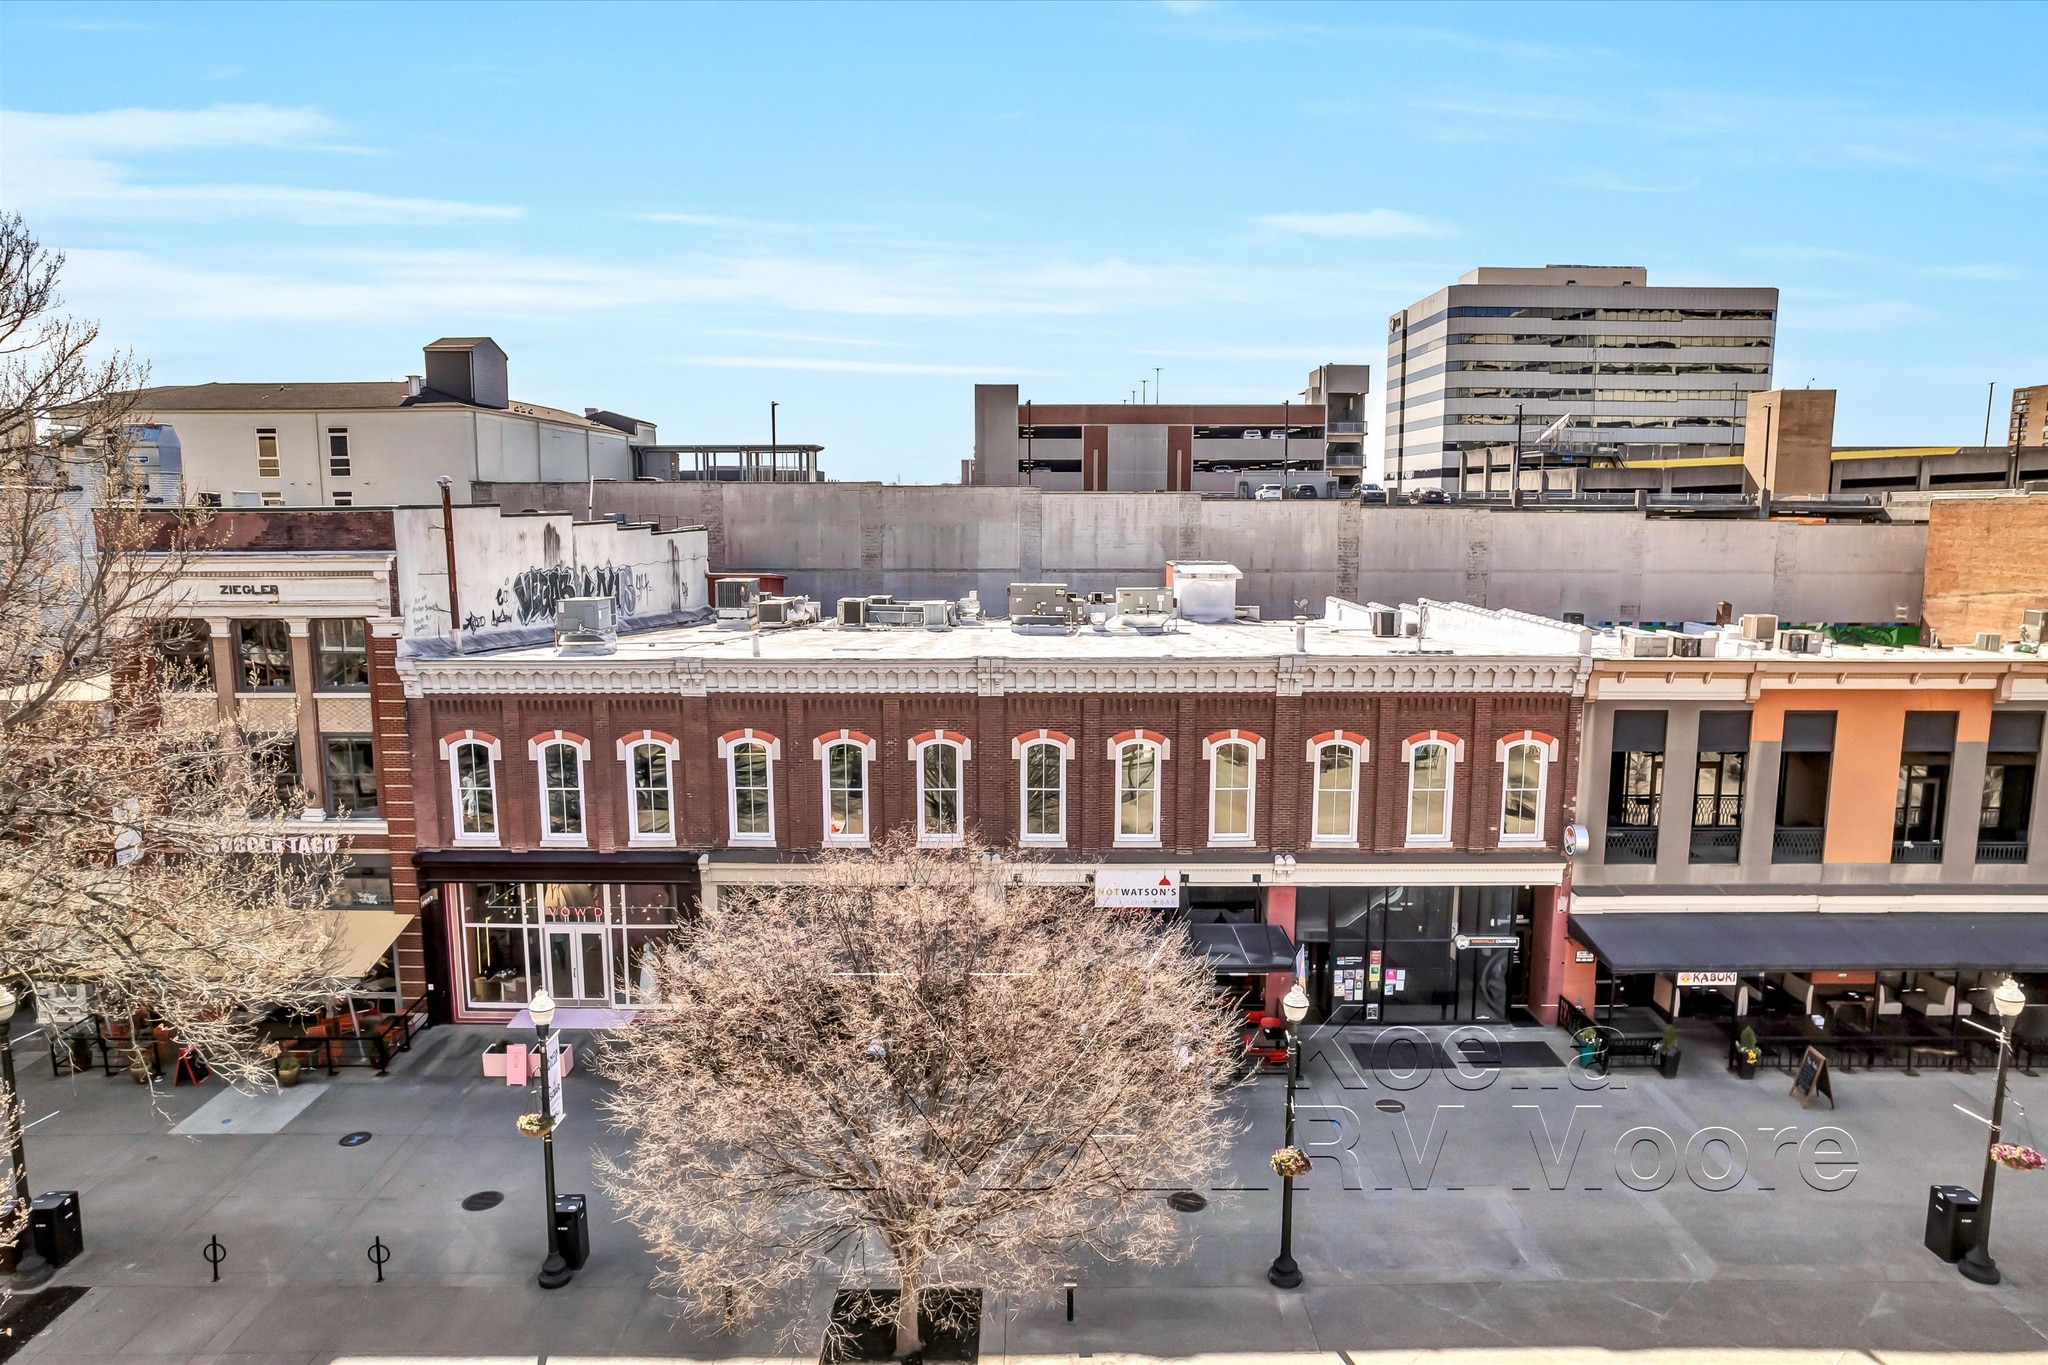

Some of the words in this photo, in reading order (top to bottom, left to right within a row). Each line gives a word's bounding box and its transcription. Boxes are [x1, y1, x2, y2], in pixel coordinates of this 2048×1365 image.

[219, 585, 279, 595] ZIEGLER
[288, 836, 339, 854] TACO
[1693, 972, 1736, 983] KABUKI
